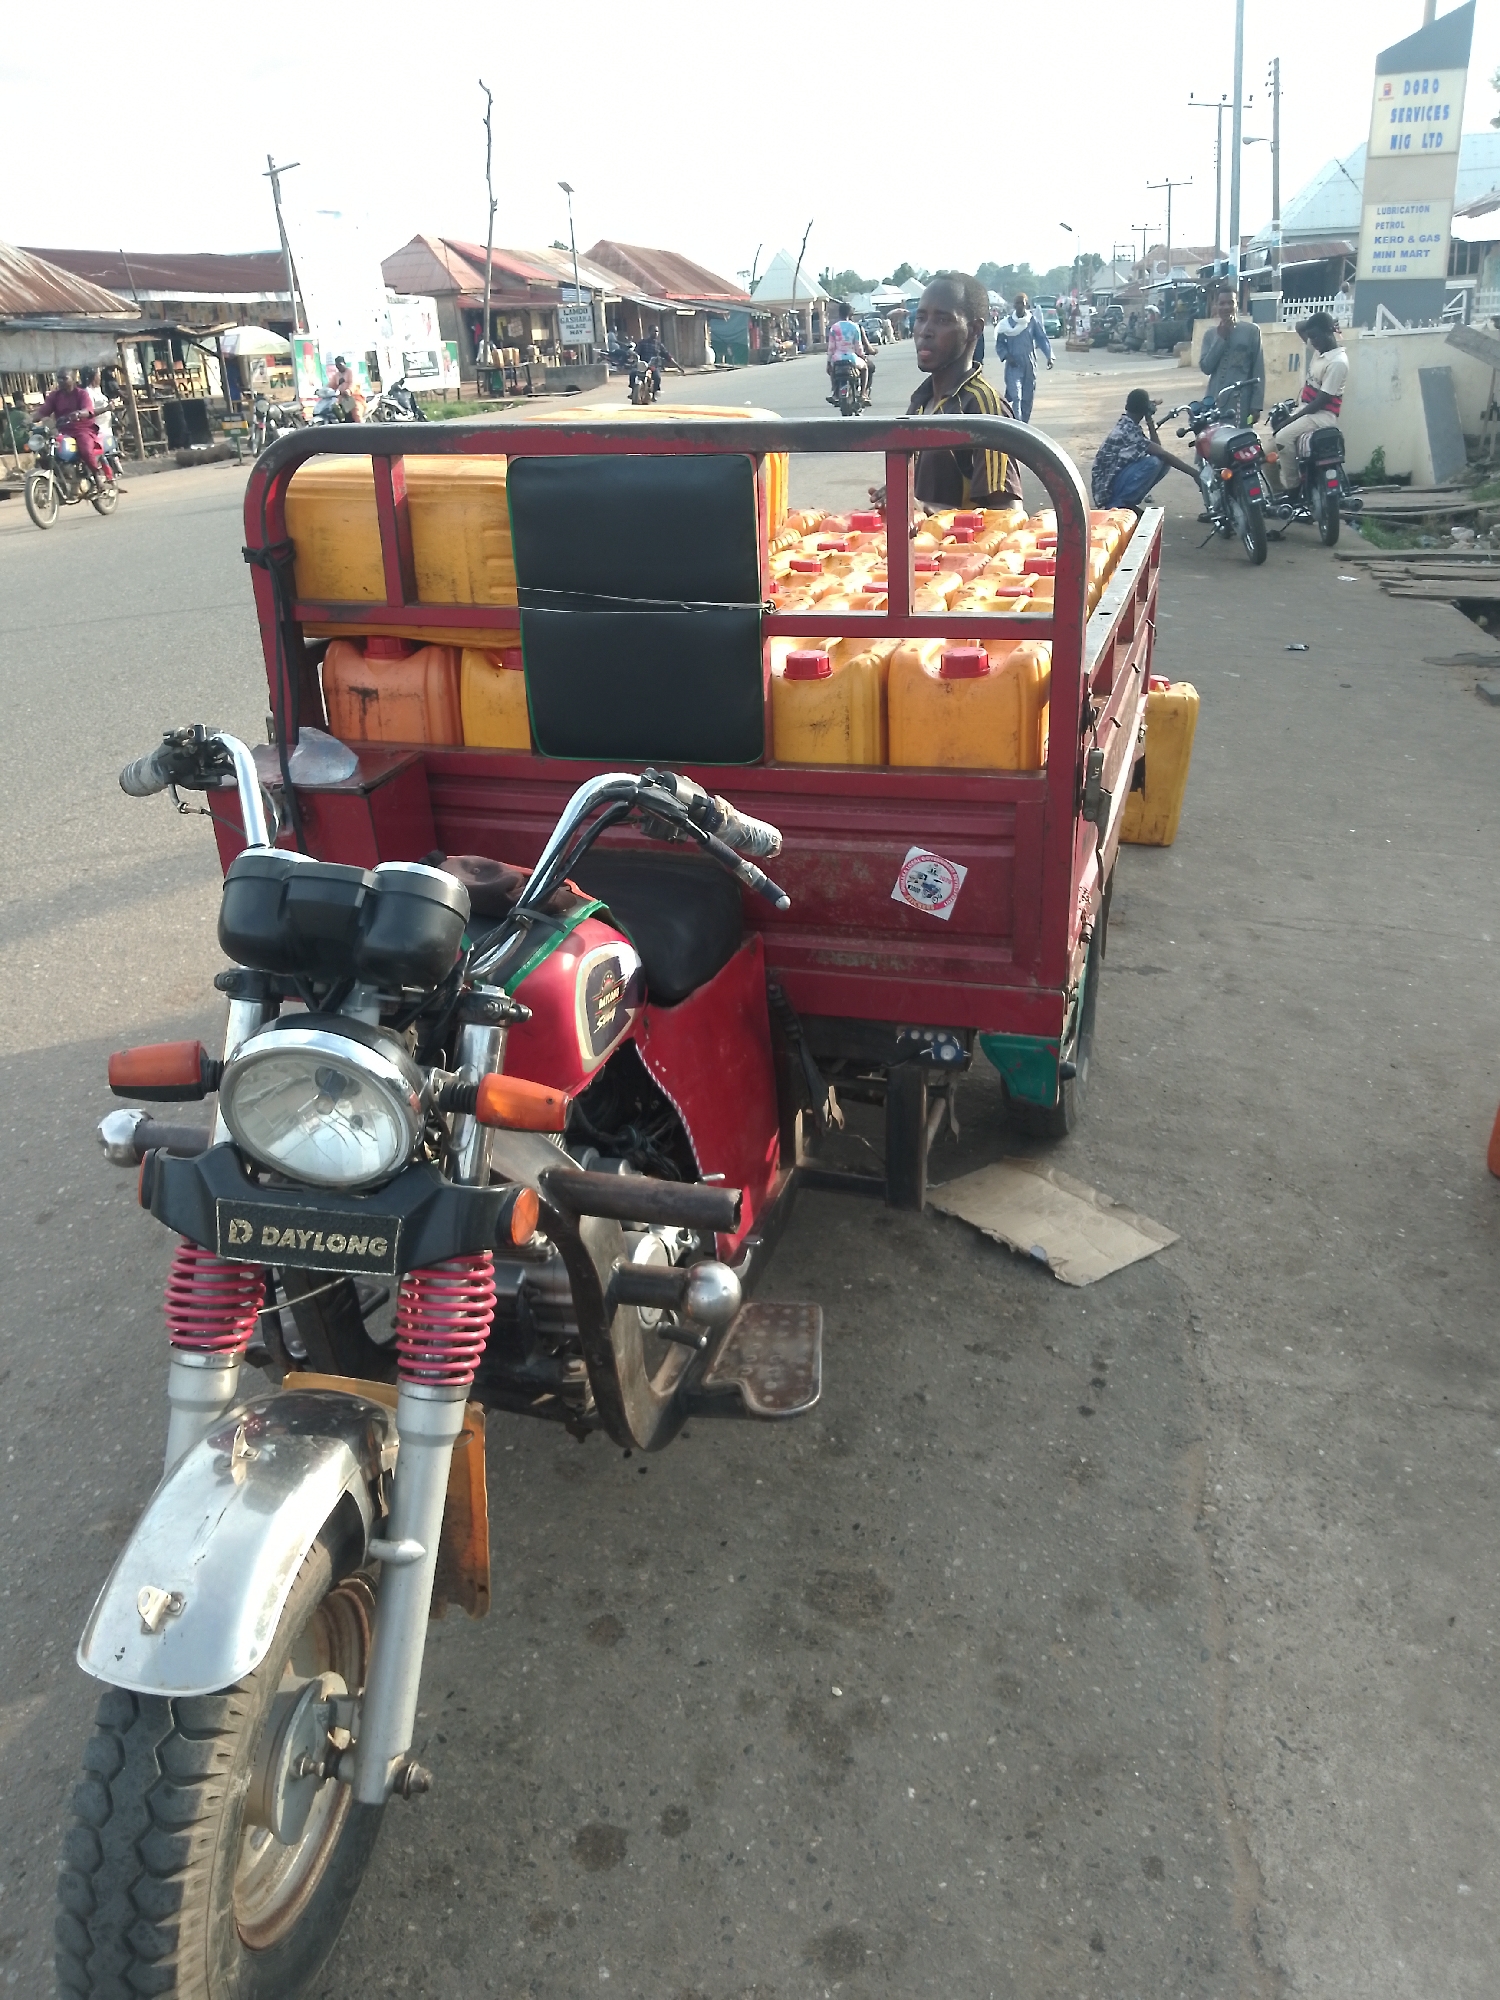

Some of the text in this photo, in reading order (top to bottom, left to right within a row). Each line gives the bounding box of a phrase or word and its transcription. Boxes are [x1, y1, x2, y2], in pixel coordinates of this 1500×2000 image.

[1404, 78, 1439, 95] DORO
[1390, 104, 1450, 123] SERVICES
[1390, 132, 1443, 150] NIG LTD
[1376, 205, 1430, 215] LUBRICATION
[1375, 221, 1405, 230] PETROL
[1374, 234, 1441, 245] KERO & GAS
[1373, 249, 1431, 259] MINI MART
[1371, 264, 1407, 274] FREE AIR
[261, 1225, 389, 1257] DAYLONG
